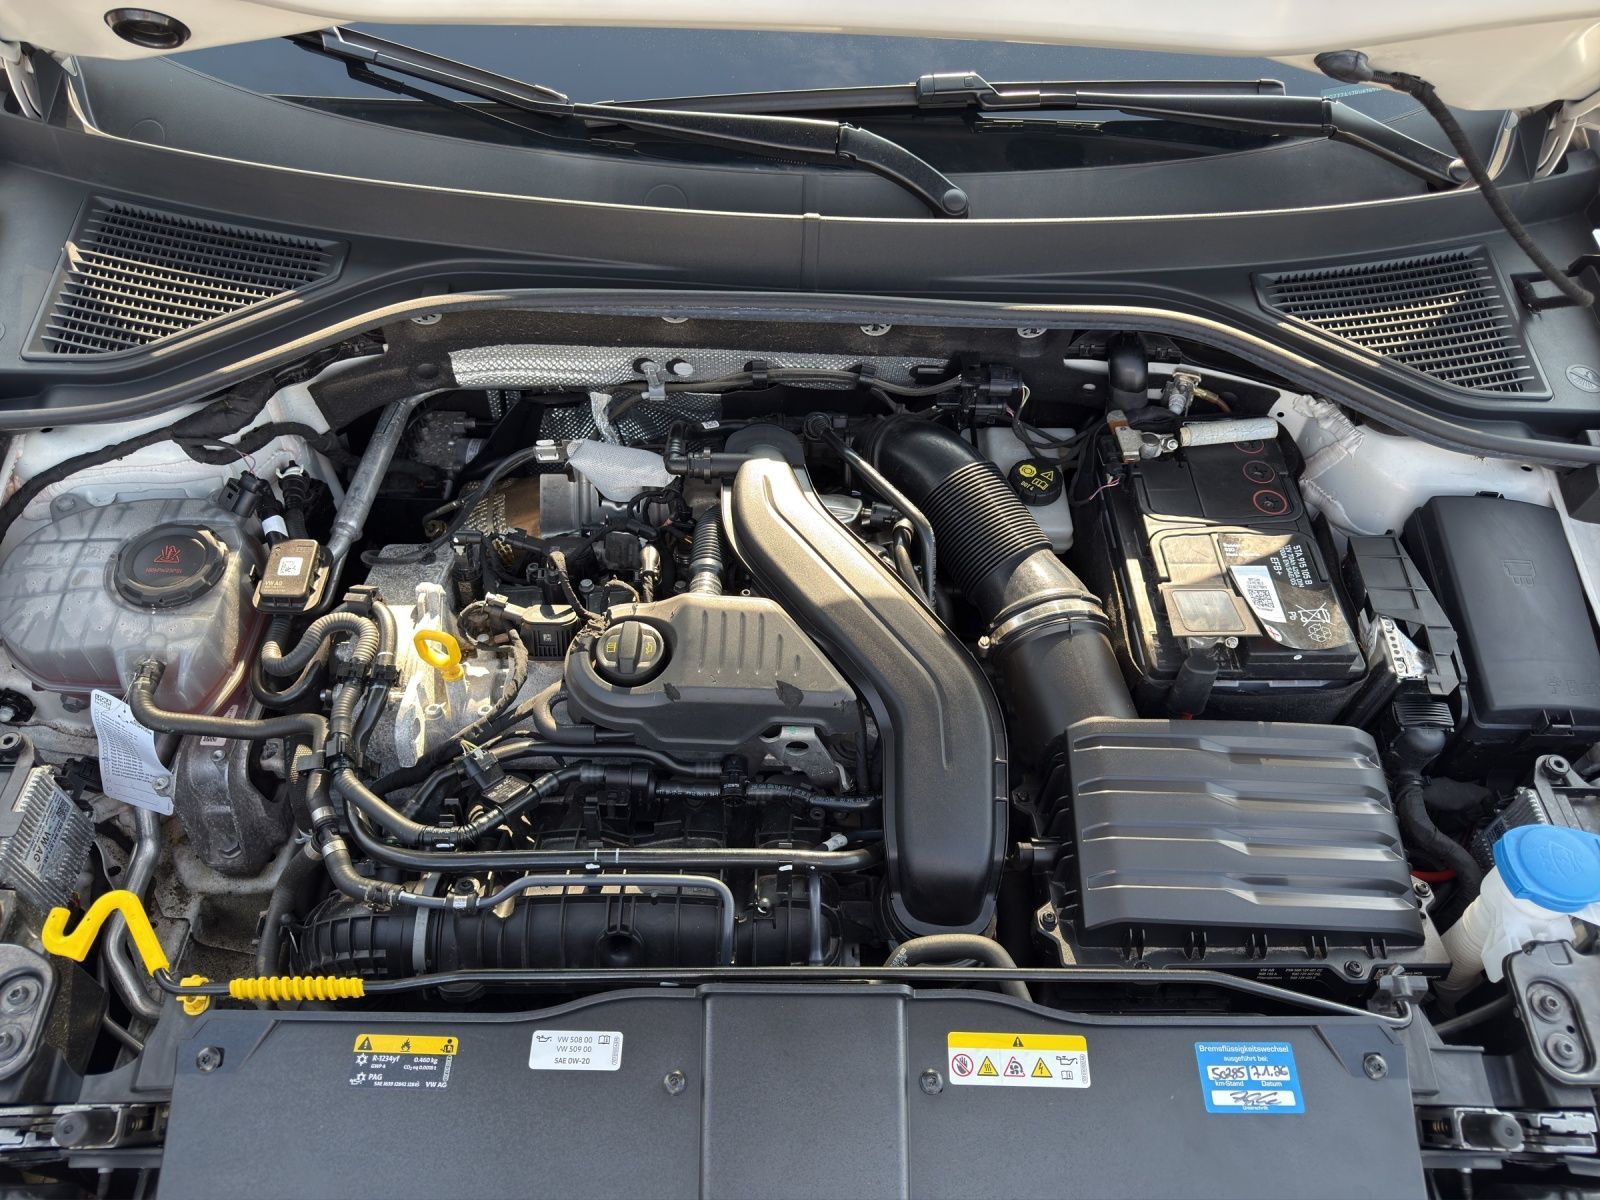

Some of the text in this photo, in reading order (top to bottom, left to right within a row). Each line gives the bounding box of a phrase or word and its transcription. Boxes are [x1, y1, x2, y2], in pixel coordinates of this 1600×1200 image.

[1293, 544, 1304, 558] 5TA
[1270, 557, 1282, 576] EFB+
[1299, 557, 1308, 569] 915
[1302, 568, 1311, 580] 105
[1288, 611, 1298, 620] Pb
[34, 832, 52, 862] VW AG
[558, 1036, 592, 1044] VW 508 00
[1199, 1045, 1288, 1054] Bremsflüssigkeitswechsel
[372, 1054, 400, 1064] R-1234yf
[431, 1057, 438, 1065] kg
